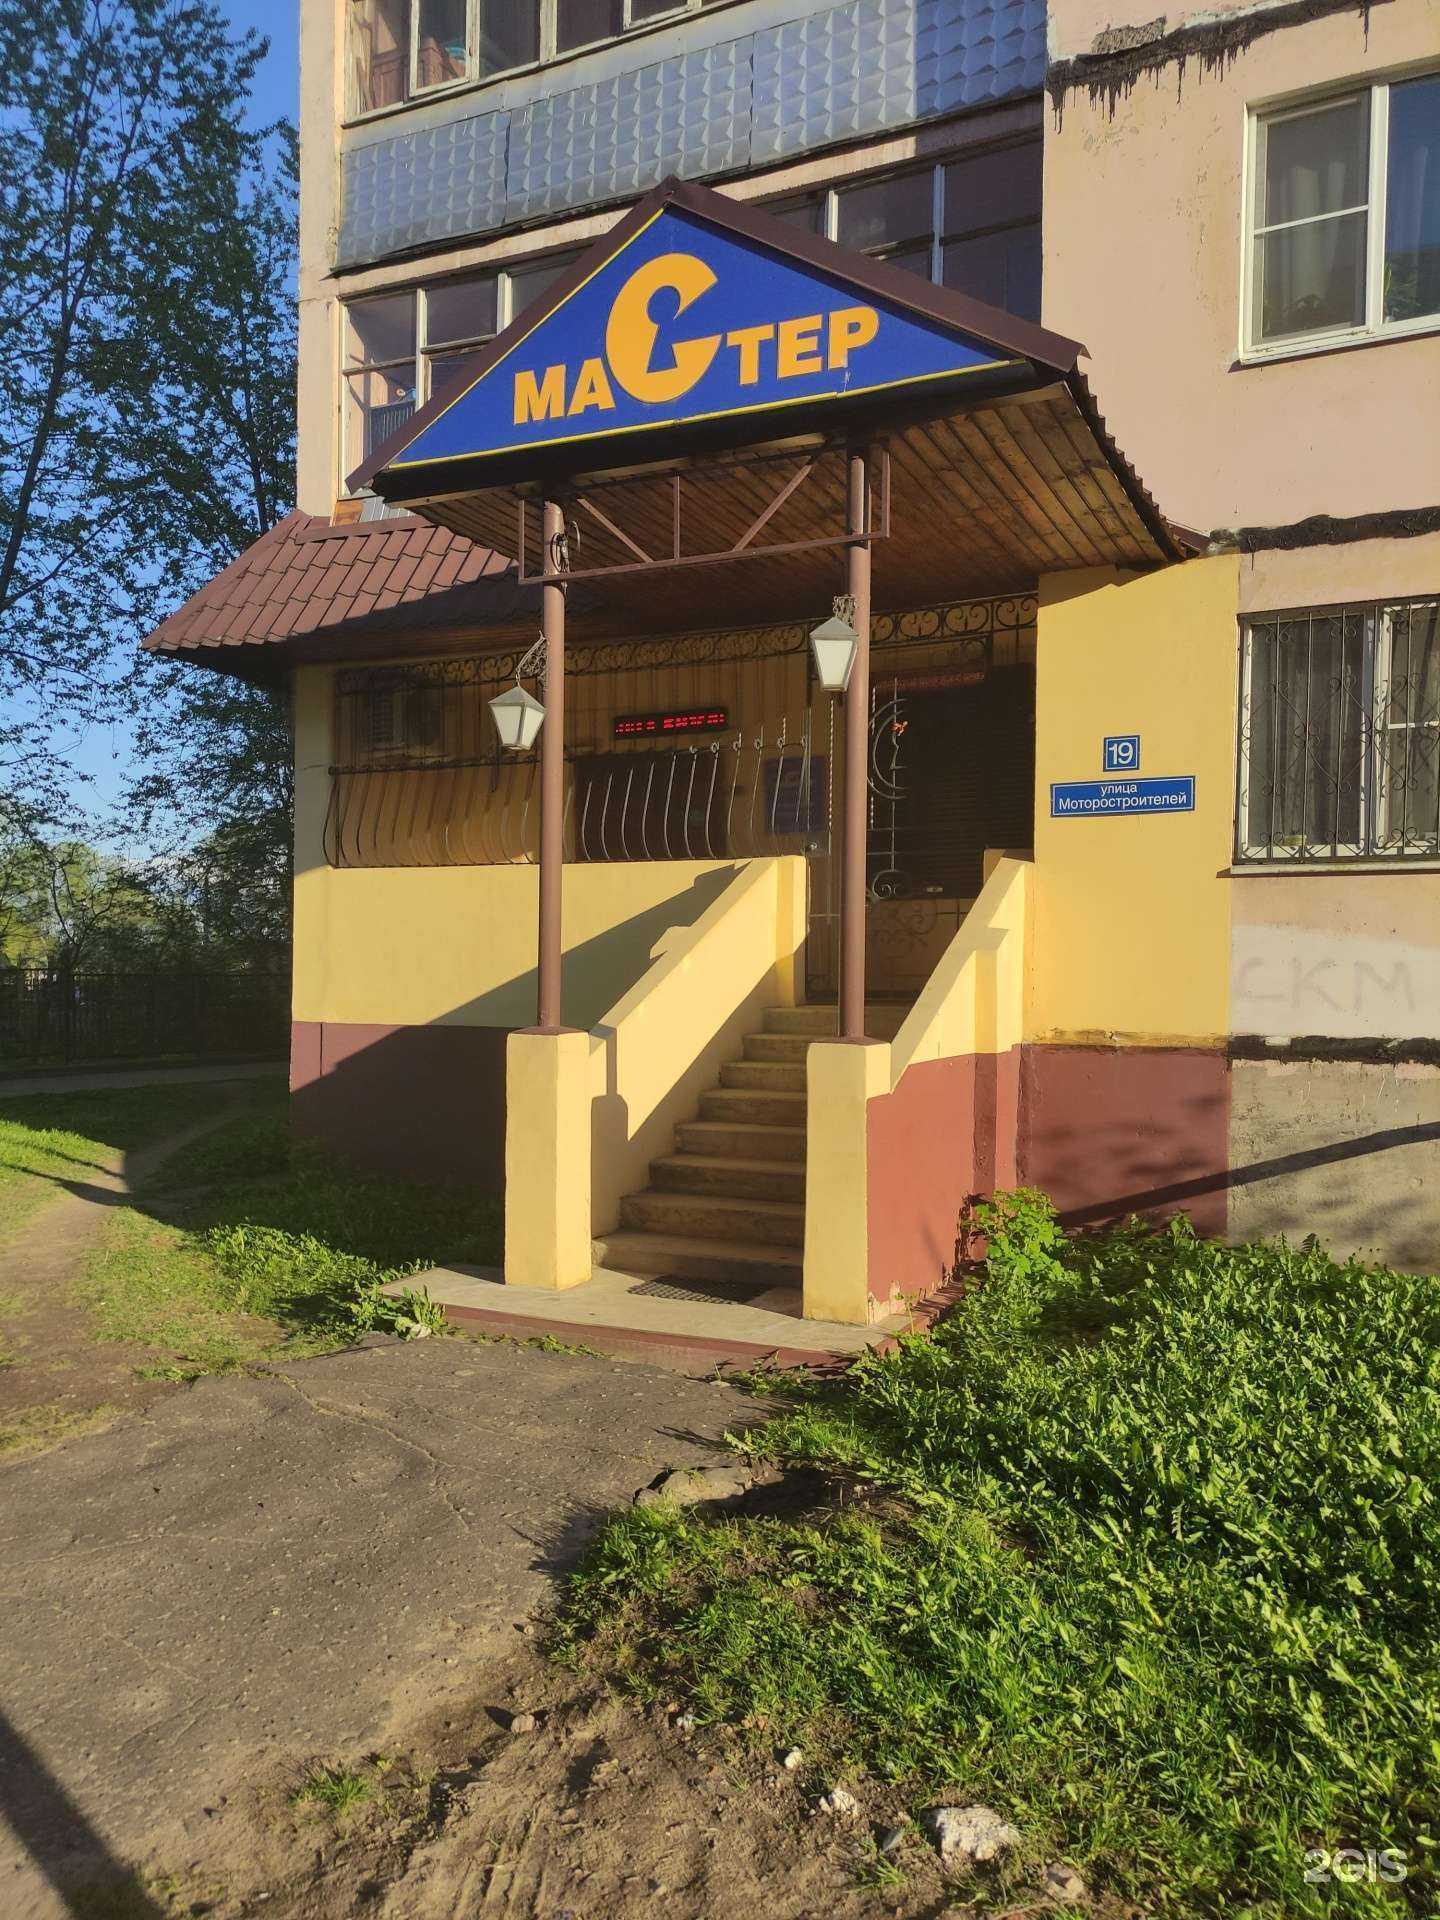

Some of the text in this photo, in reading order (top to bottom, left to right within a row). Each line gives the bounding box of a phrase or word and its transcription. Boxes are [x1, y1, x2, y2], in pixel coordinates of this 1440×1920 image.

[513, 253, 879, 425] МАСТЕР
[1108, 742, 1134, 765] 19
[1100, 783, 1138, 797] улица
[1058, 792, 1187, 810] Моторостроителей
